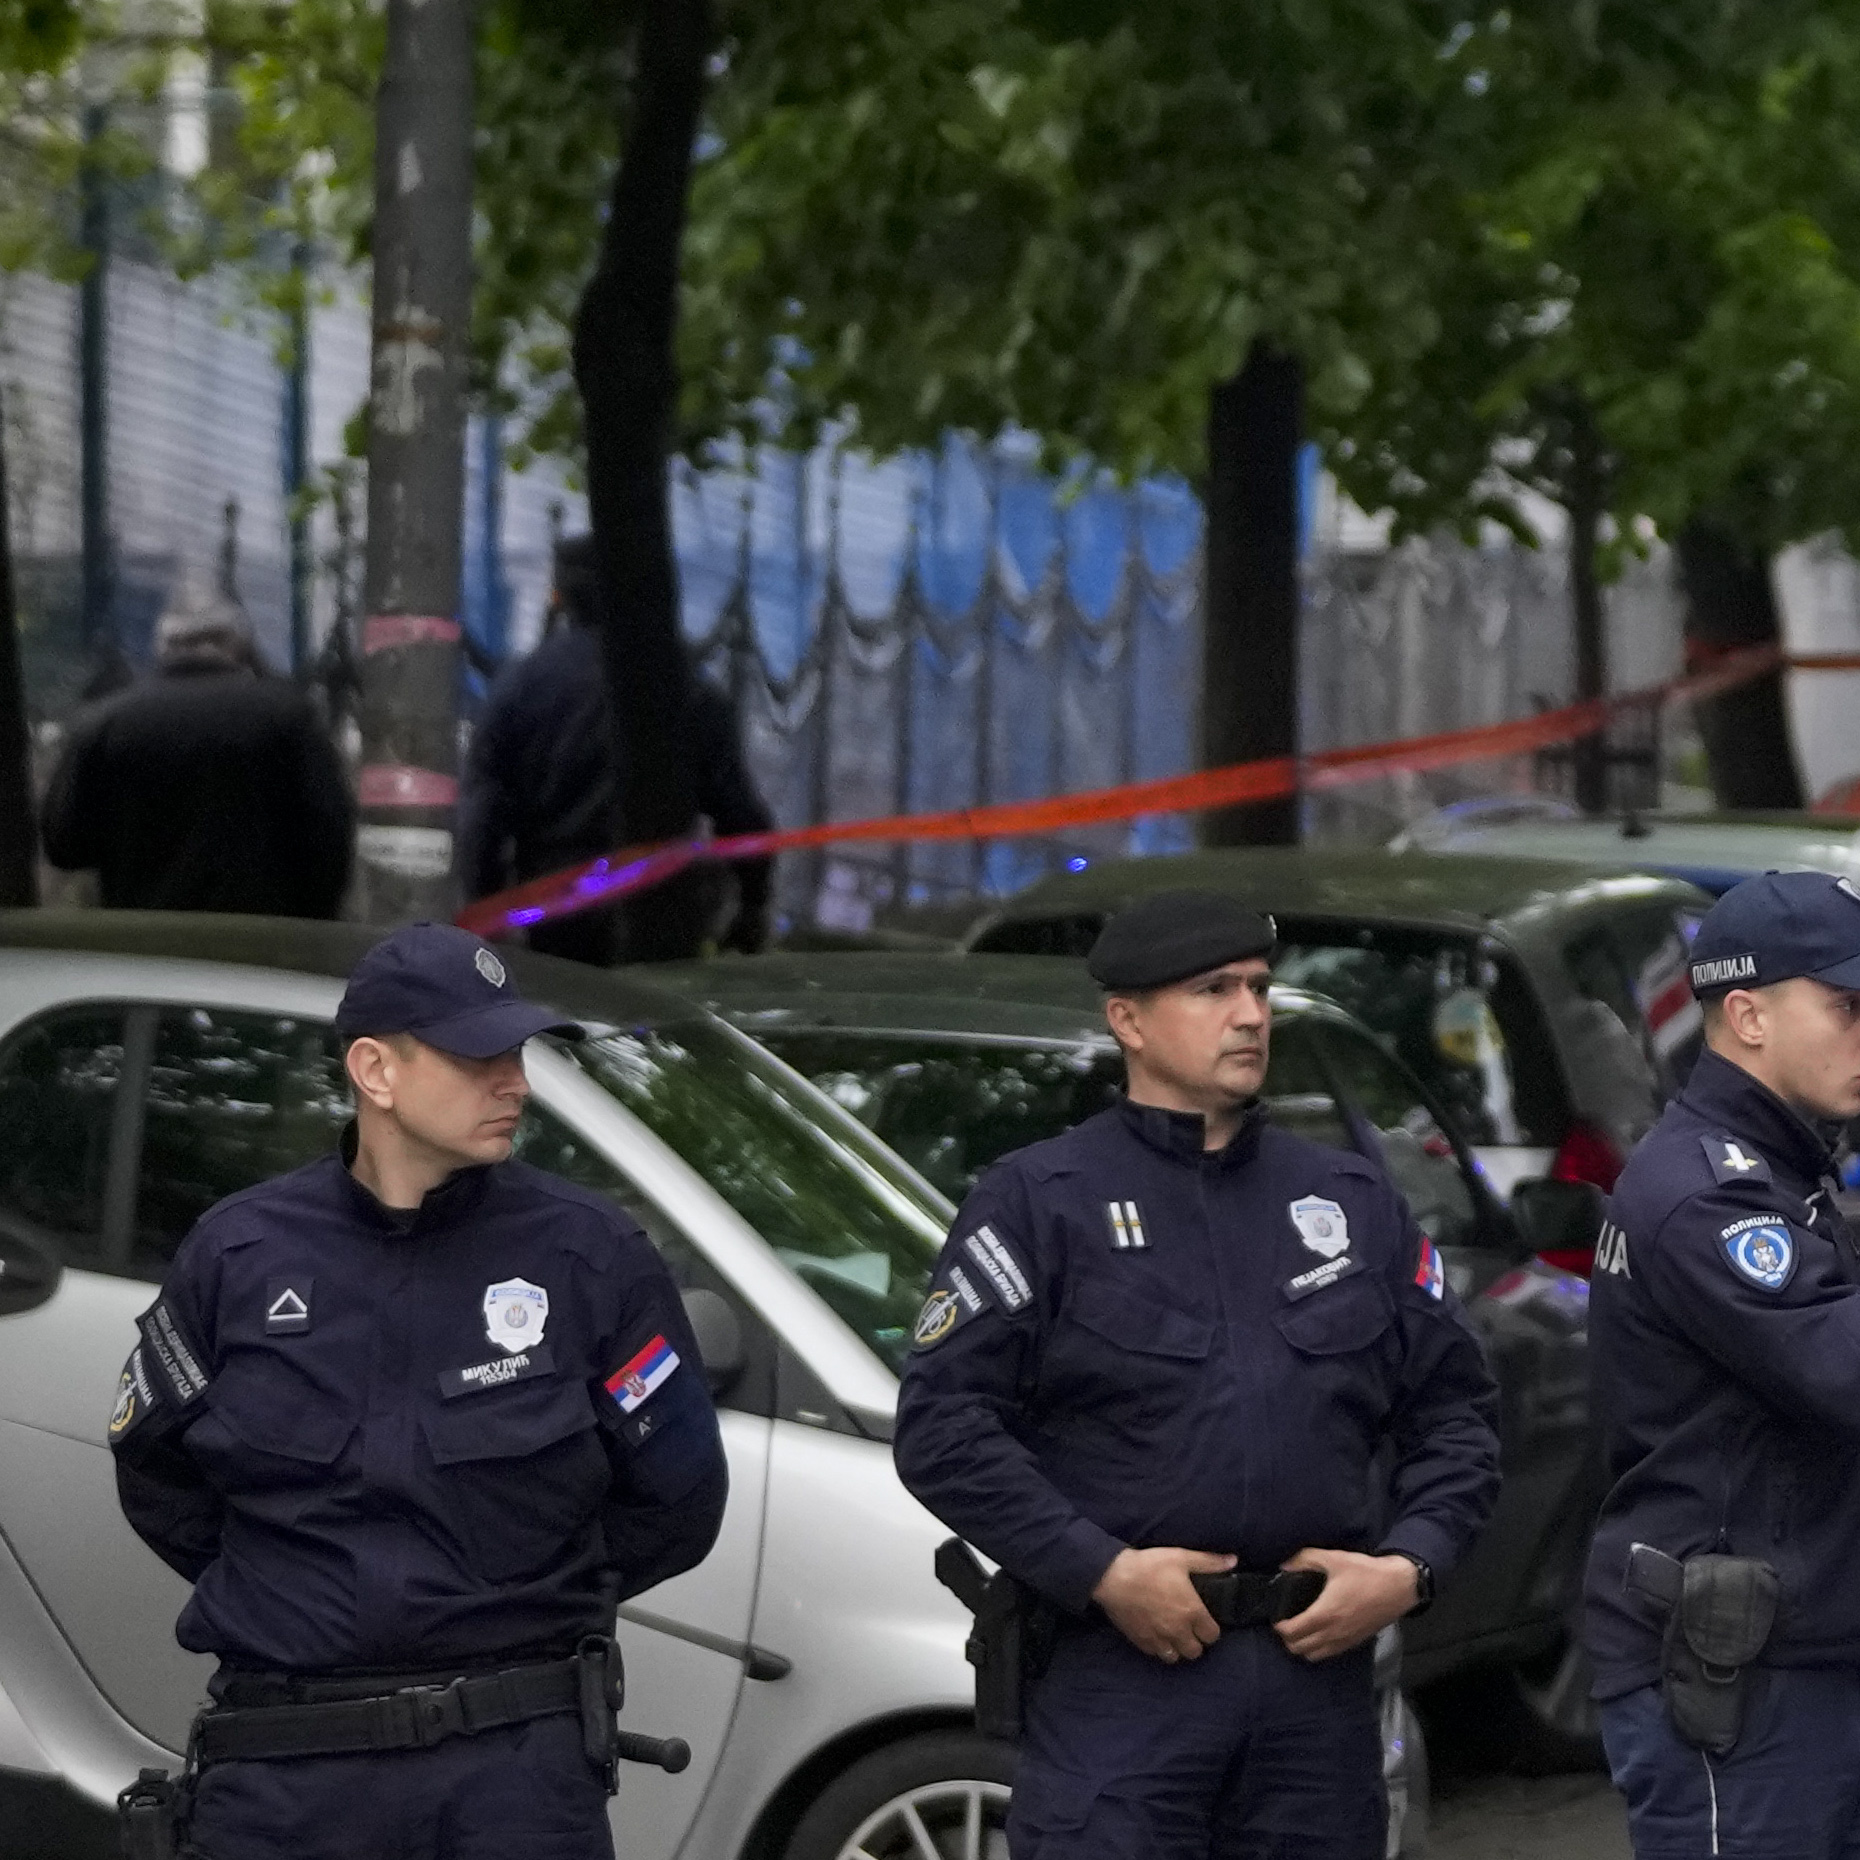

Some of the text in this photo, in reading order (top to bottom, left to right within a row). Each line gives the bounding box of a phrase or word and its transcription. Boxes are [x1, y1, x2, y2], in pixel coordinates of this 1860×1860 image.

[1692, 955, 1757, 985] ПОЛИЦИЈА
[1721, 1215, 1785, 1239] ПОЛИЦИЈА
[462, 1354, 530, 1381] МИКУЛИЋ
